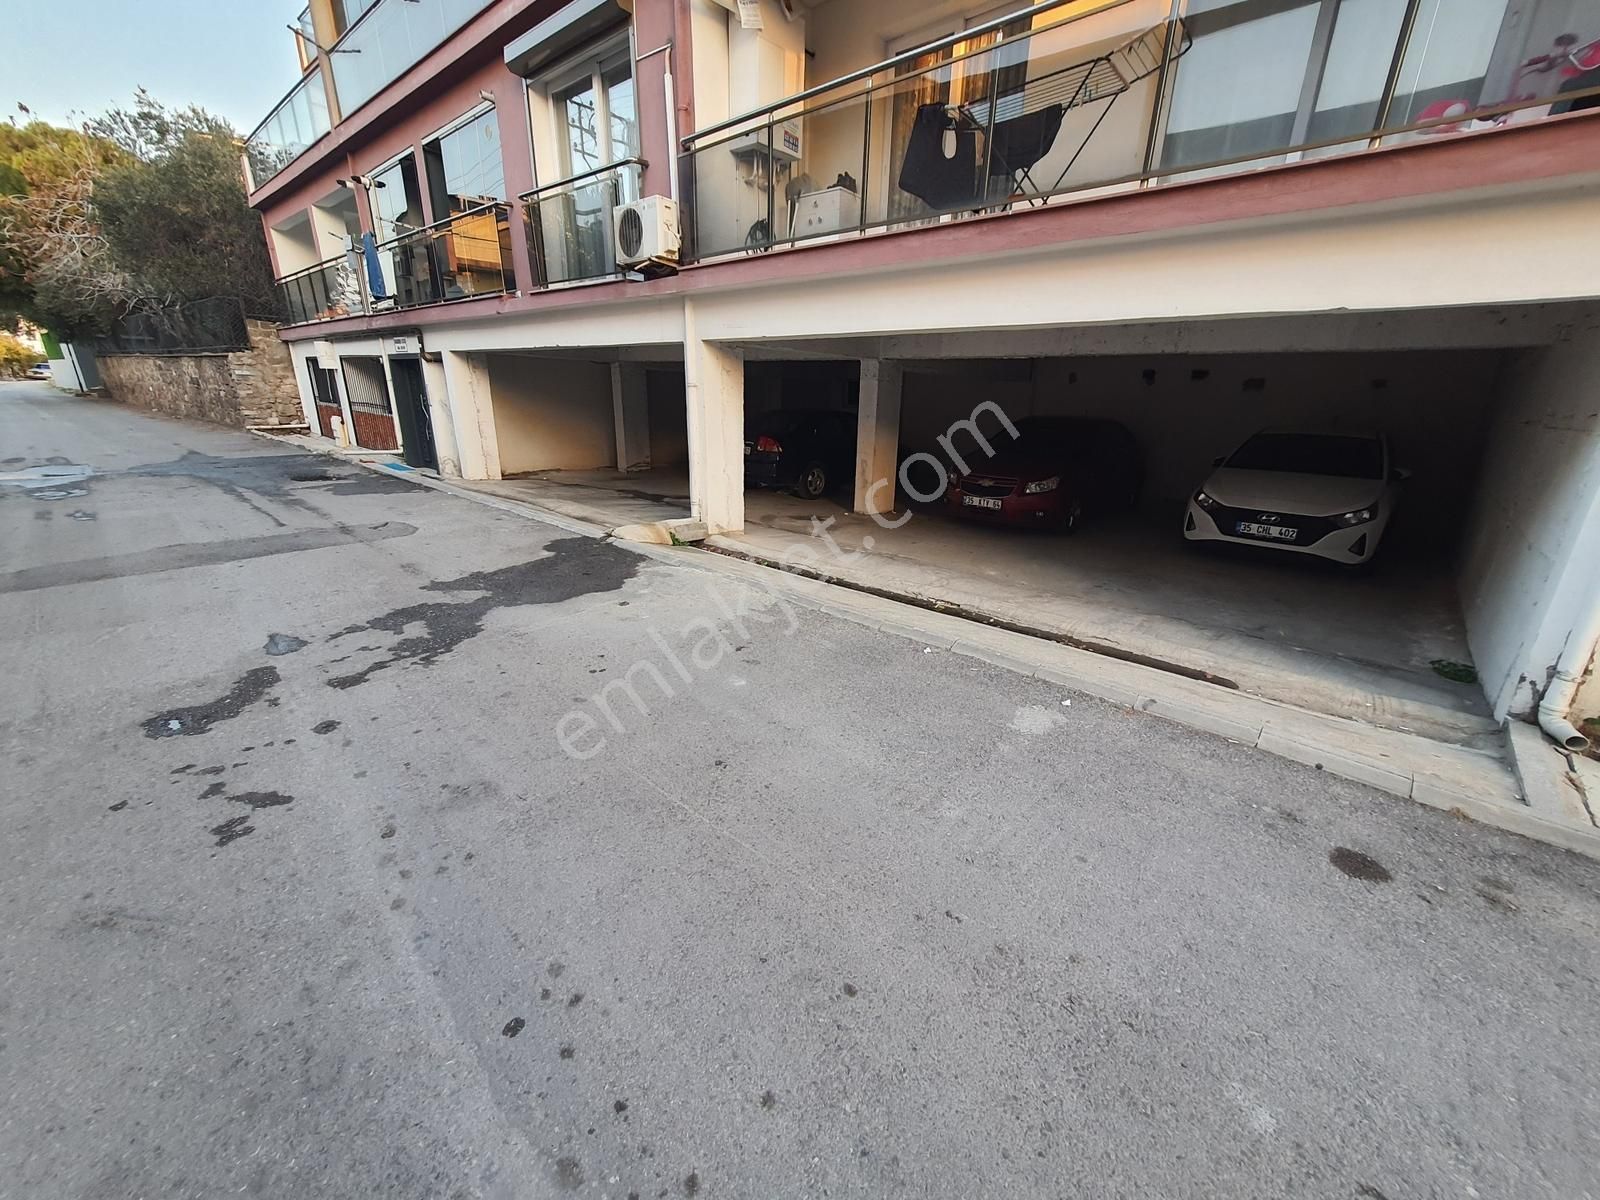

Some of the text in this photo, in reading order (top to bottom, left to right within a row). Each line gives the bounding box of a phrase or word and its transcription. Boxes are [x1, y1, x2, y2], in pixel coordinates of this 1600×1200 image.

[966, 496, 974, 505] 35
[1241, 523, 1296, 539] 35 CHL 402
